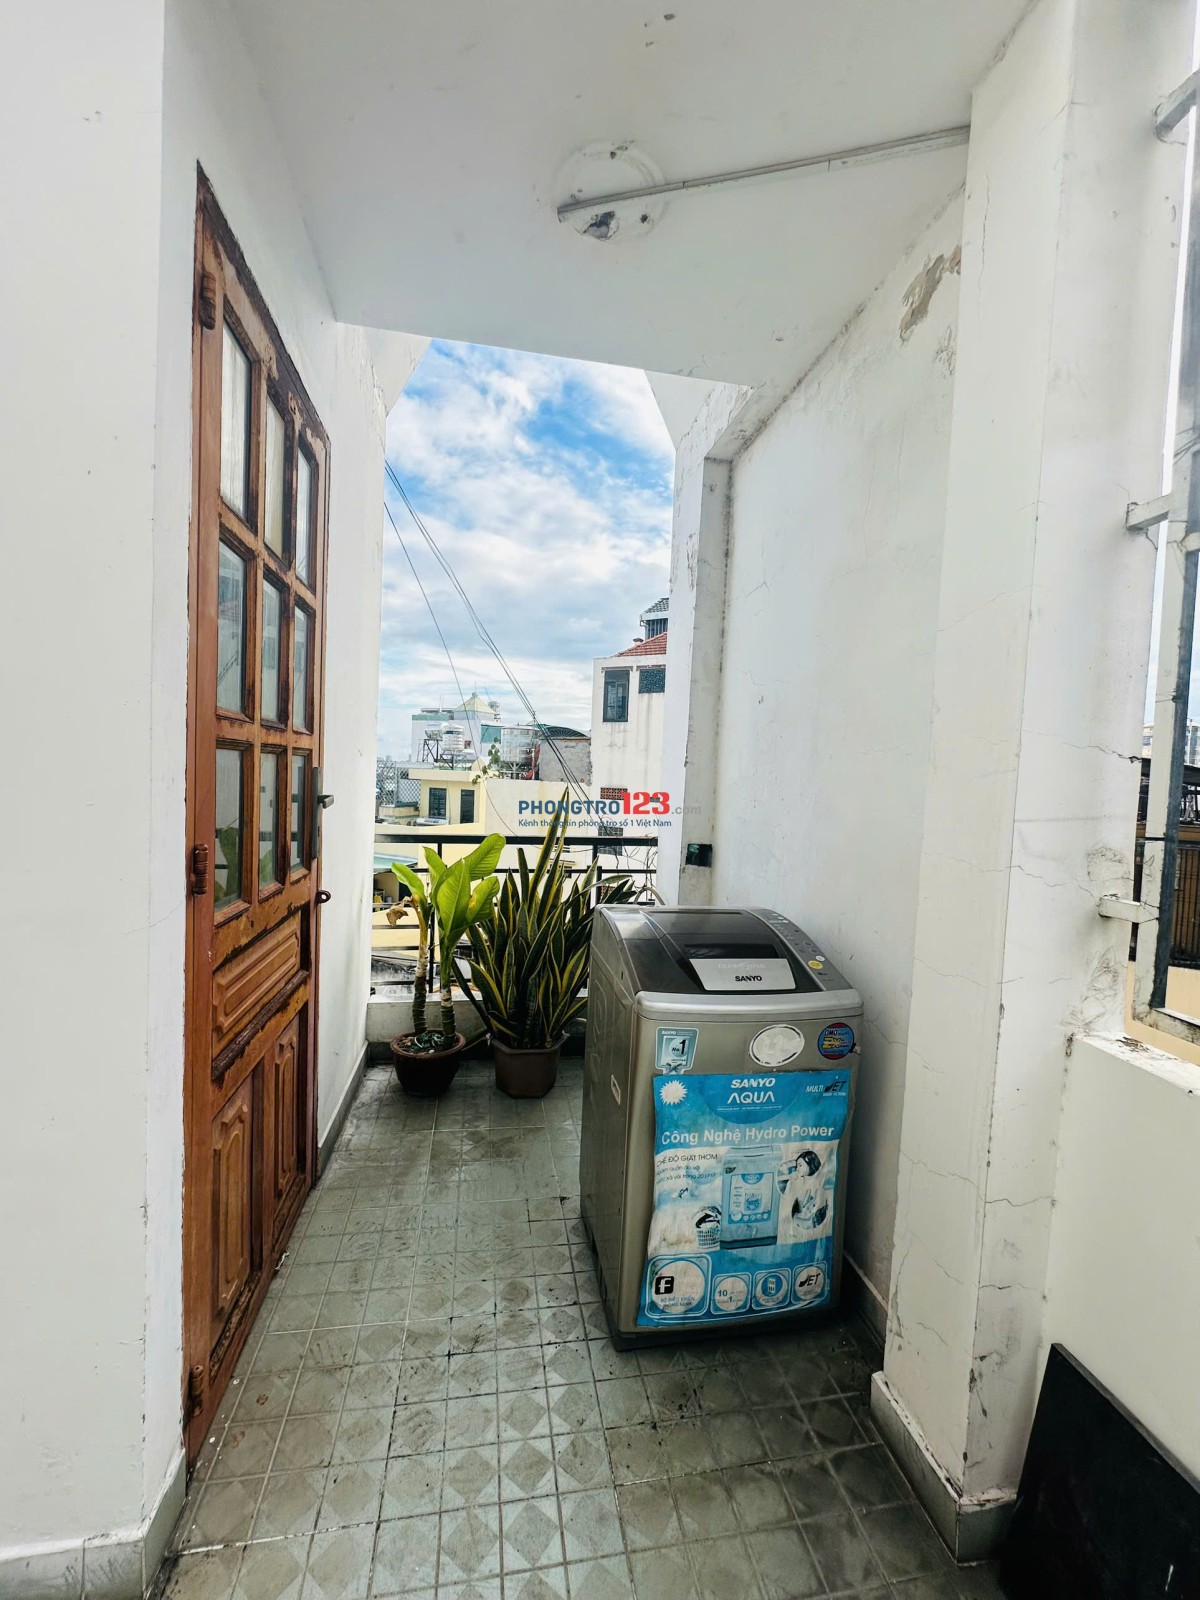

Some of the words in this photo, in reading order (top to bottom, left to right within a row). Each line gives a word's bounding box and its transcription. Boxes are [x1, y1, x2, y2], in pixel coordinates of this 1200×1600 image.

[679, 1039, 687, 1055] 1
[730, 1077, 777, 1089] SANYO
[805, 1084, 824, 1093] MULTI
[727, 1090, 776, 1105] AQUA
[661, 1130, 699, 1146] Công
[703, 1127, 742, 1145] Nghệ
[745, 1126, 788, 1143] Hydro
[791, 1124, 836, 1138] Power
[717, 1289, 728, 1297] 10
